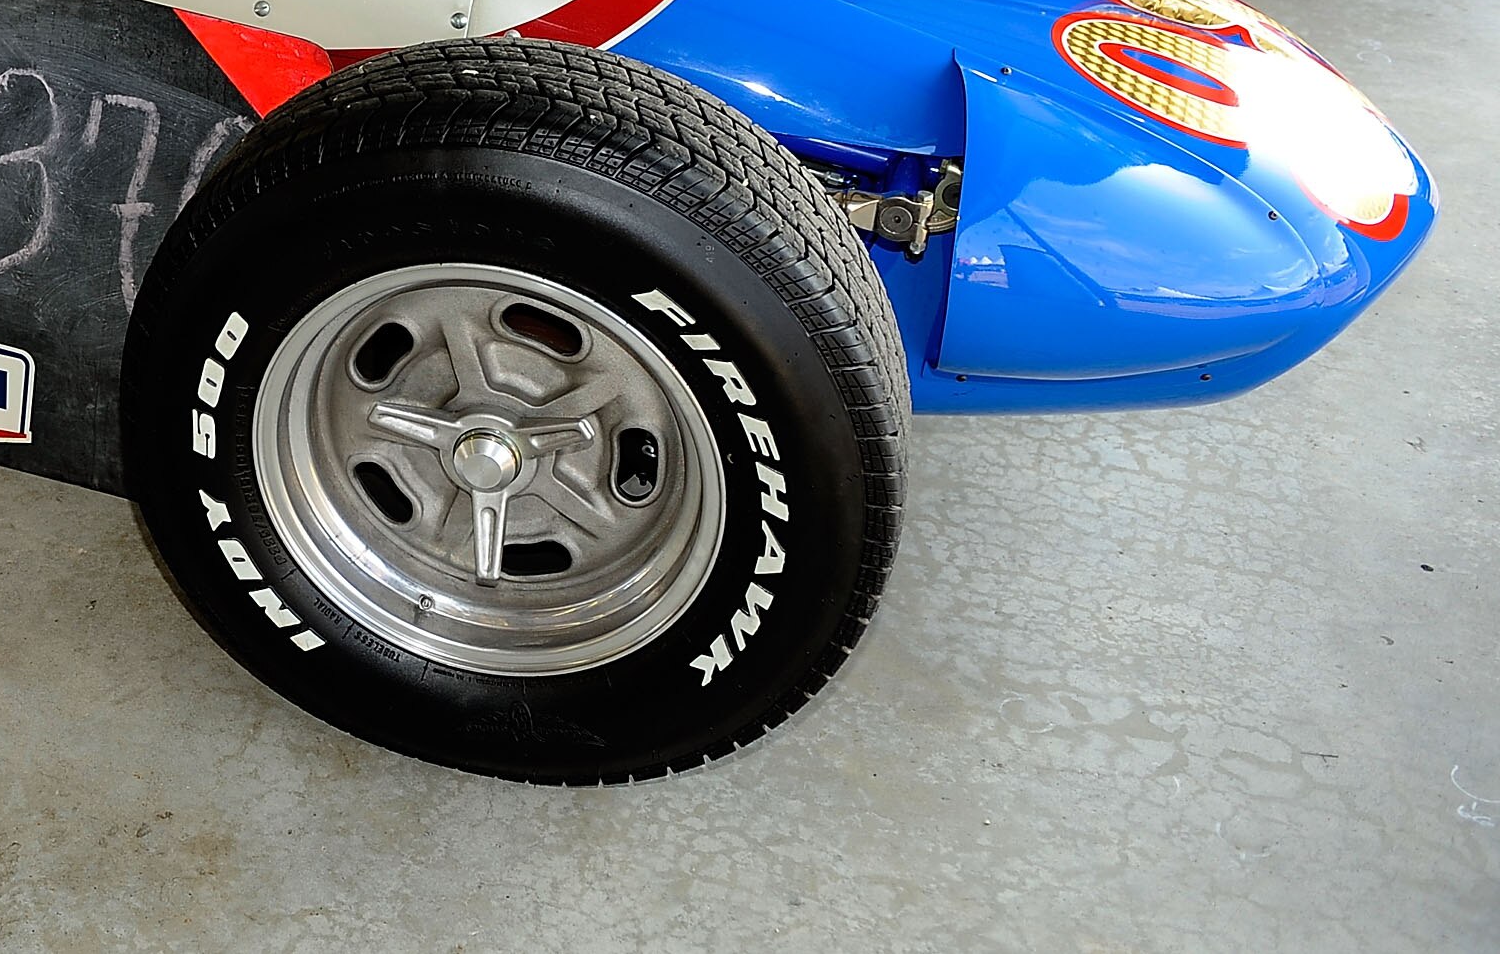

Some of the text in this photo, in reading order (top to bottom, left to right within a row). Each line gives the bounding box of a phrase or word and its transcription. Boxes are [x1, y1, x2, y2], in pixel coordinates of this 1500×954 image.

[192, 311, 249, 460] 500
[631, 288, 790, 687] FIREHAWK
[199, 490, 326, 652] INDY
